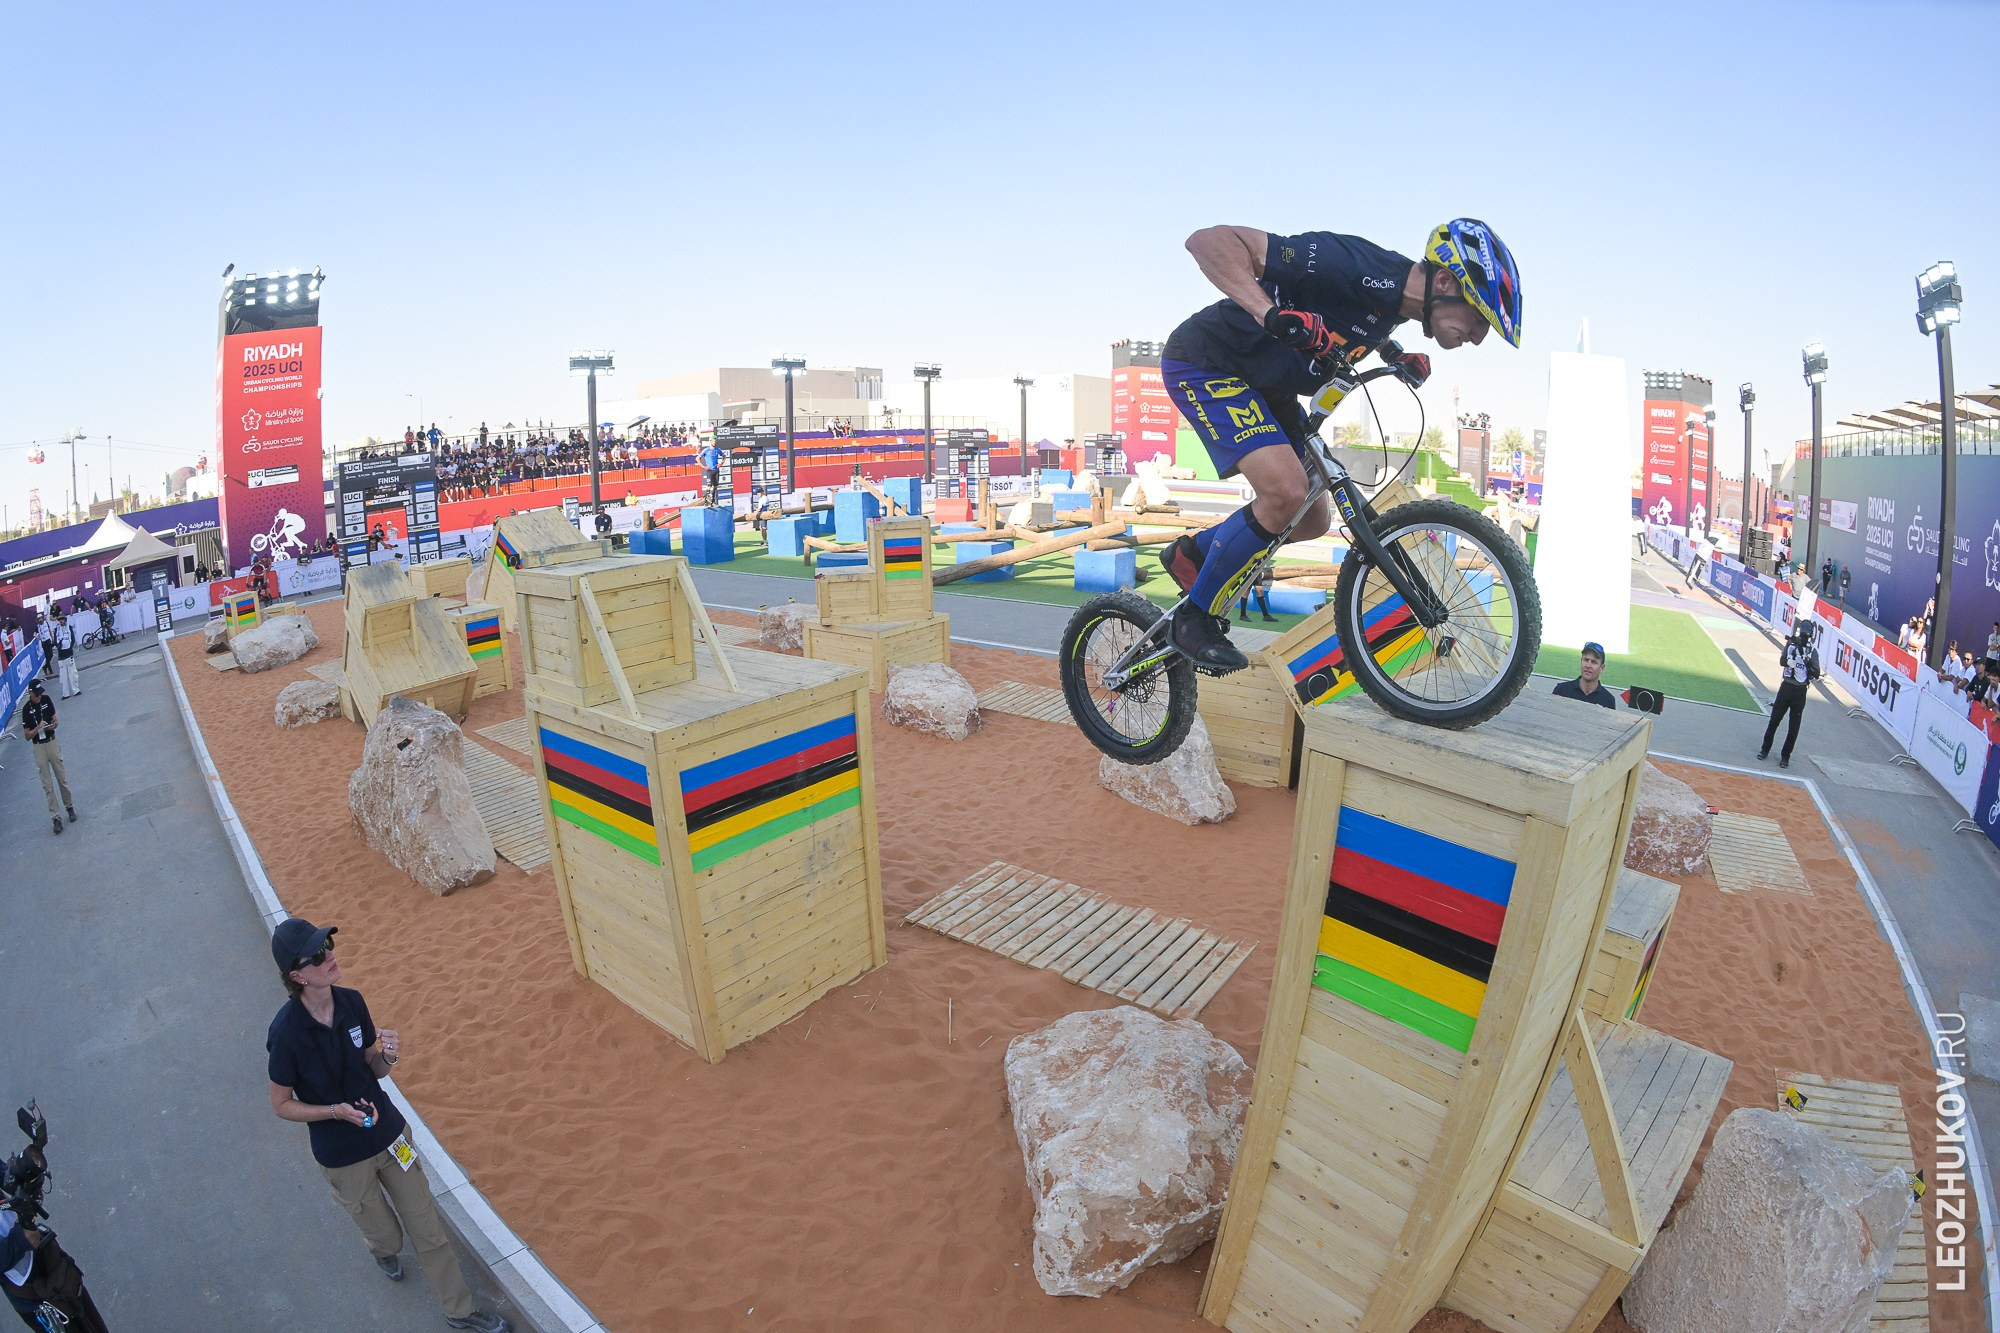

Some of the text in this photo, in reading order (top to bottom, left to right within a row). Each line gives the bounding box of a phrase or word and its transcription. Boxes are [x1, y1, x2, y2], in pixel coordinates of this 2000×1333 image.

[1307, 243, 1317, 273] RALI
[1434, 242, 1467, 280] WD-40
[244, 342, 303, 363] RIYADH
[243, 360, 303, 378] 2025 UCI
[243, 382, 303, 394] CHAMPIONSHIPS
[1650, 407, 1676, 418] RIYADH
[1233, 424, 1278, 443] COMAS
[280, 436, 304, 444] CYCLING
[347, 464, 361, 472] UCI
[250, 470, 264, 478] UCI
[378, 476, 400, 485] FINISH
[347, 492, 361, 501] UCI
[569, 509, 576, 519] 2
[1512, 505, 1540, 515] TISSO
[1867, 496, 1895, 523] RIYADH
[1866, 524, 1894, 549] 2025 UCI
[158, 586, 164, 597] 1
[1852, 649, 1901, 712] TISSOT
